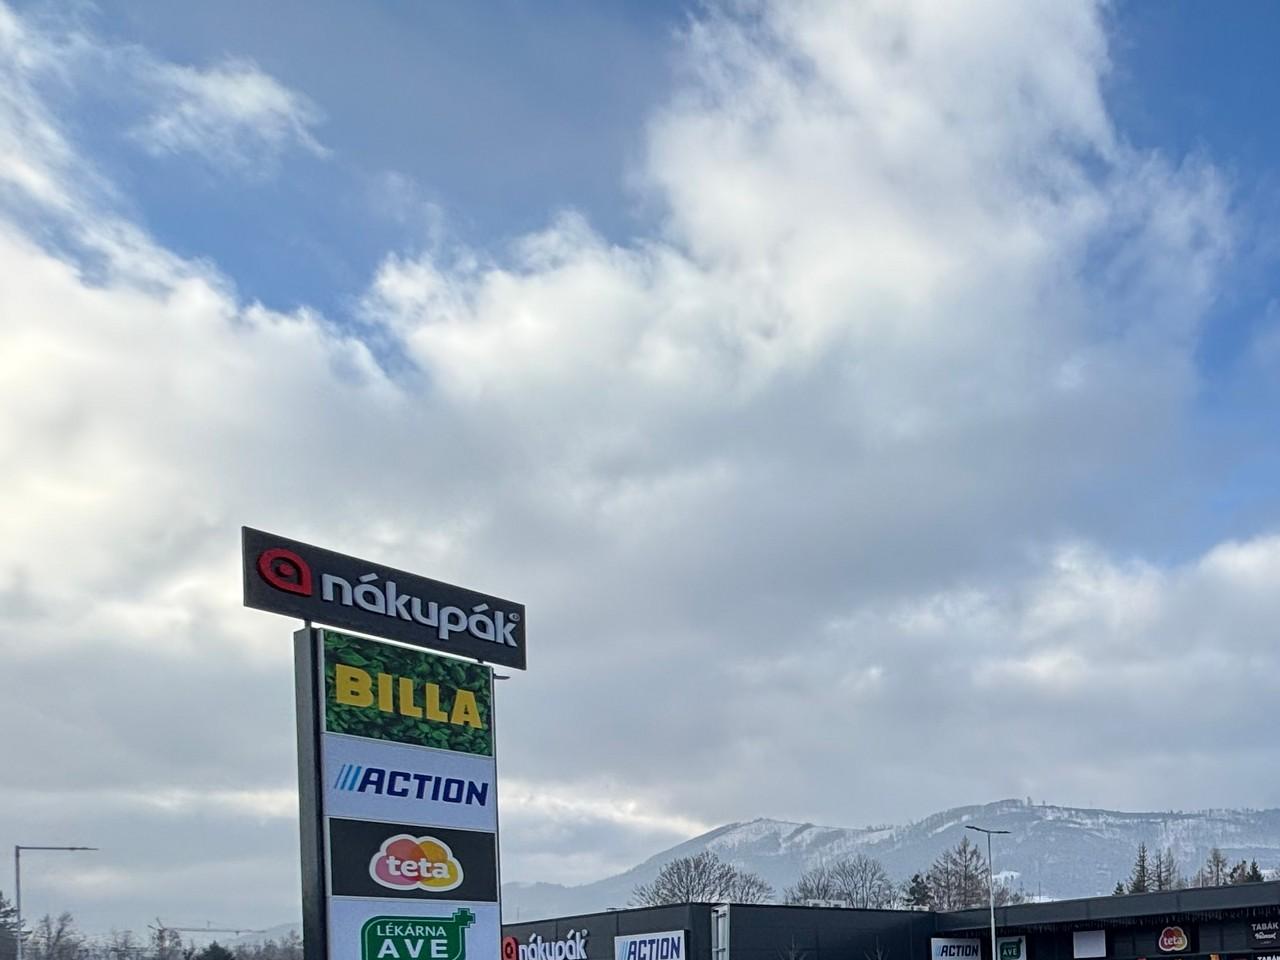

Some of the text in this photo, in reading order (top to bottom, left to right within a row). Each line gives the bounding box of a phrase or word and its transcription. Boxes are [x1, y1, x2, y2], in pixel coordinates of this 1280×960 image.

[321, 572, 518, 648] nákupák
[335, 663, 483, 729] BILLA
[357, 767, 489, 807] ACTION
[386, 855, 450, 880] teta
[376, 922, 448, 937] LÉKÁRNA
[1251, 921, 1280, 931] TABÁK
[377, 938, 449, 959] AVE
[940, 944, 979, 957] ACTION
[1163, 937, 1183, 946] teta
[1002, 948, 1018, 957] AVE
